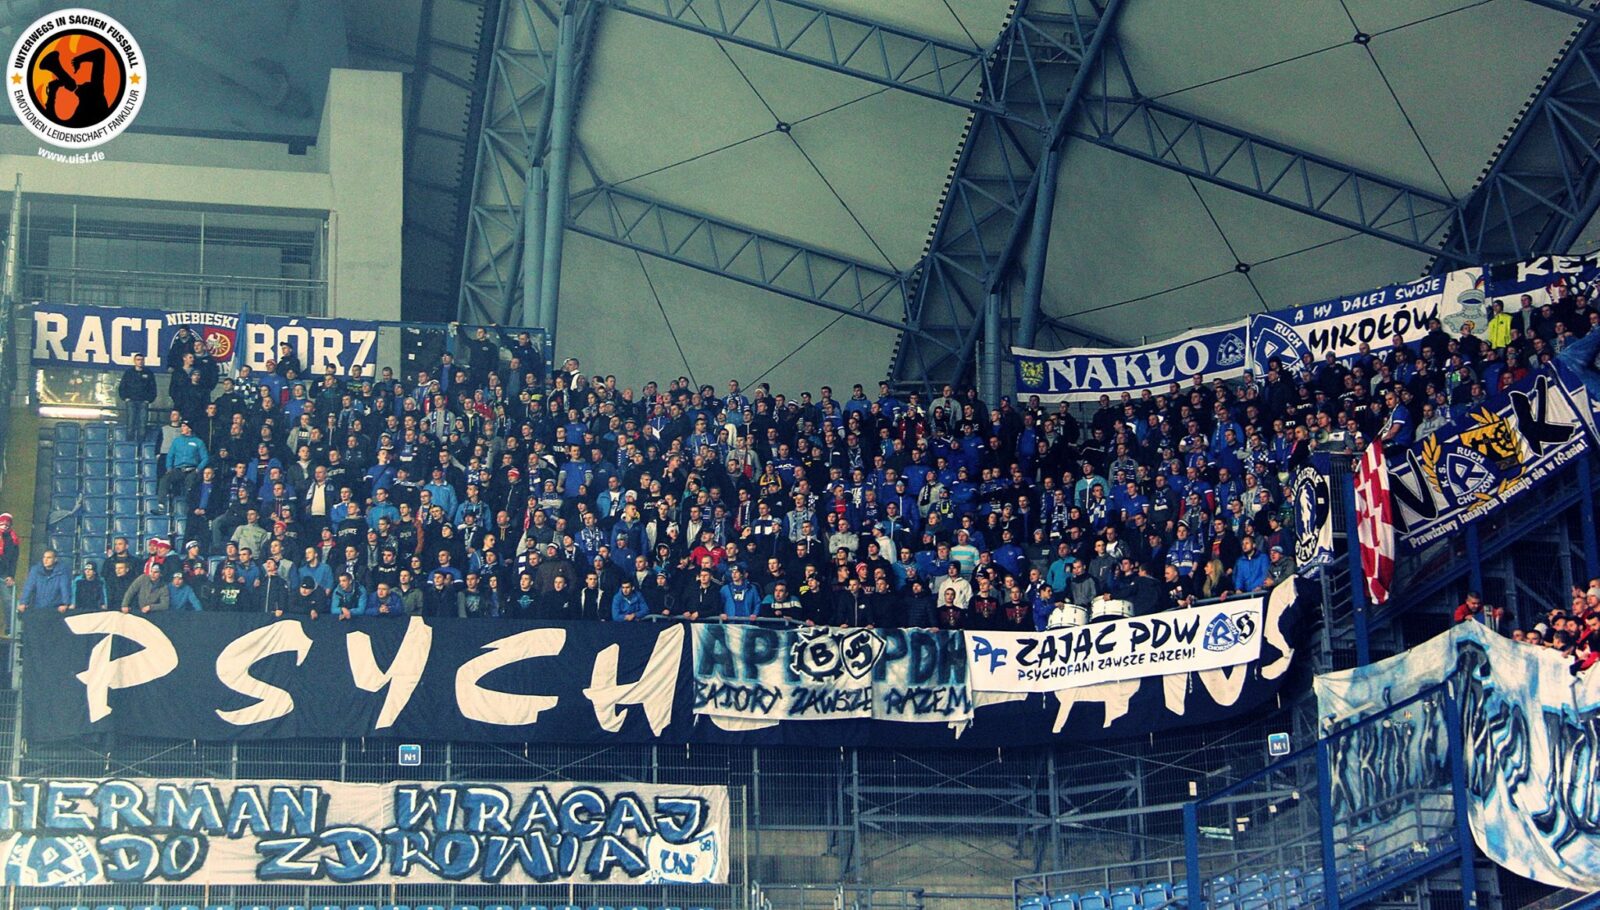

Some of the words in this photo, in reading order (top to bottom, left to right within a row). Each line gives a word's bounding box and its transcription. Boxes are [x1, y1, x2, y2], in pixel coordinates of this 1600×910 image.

[1294, 310, 1304, 323] A
[1313, 303, 1332, 319] MY
[1341, 291, 1386, 313] DALEJ
[1395, 278, 1440, 300] SWOJE
[33, 311, 162, 367] RACI
[165, 312, 239, 330] NIEBIESKI
[1273, 322, 1303, 349] RUCH
[1308, 303, 1438, 354] MIKOŁÓW
[1047, 340, 1210, 392] NAKŁO
[1456, 446, 1485, 464] RUCH
[1408, 520, 1459, 549] Prawdziwy
[1128, 614, 1200, 652] PDW
[1017, 660, 1094, 682] PSYCHOFANI
[1097, 653, 1145, 670] ZAWSZE
[1149, 647, 1196, 664] RAZEM!
[788, 685, 873, 716] ZAWSZE
[884, 685, 971, 716] RAZEM
[0, 779, 331, 839] HERMAN
[394, 783, 709, 844] WRACAJ
[98, 832, 208, 883] DO
[255, 827, 649, 884] ZDROWIA
